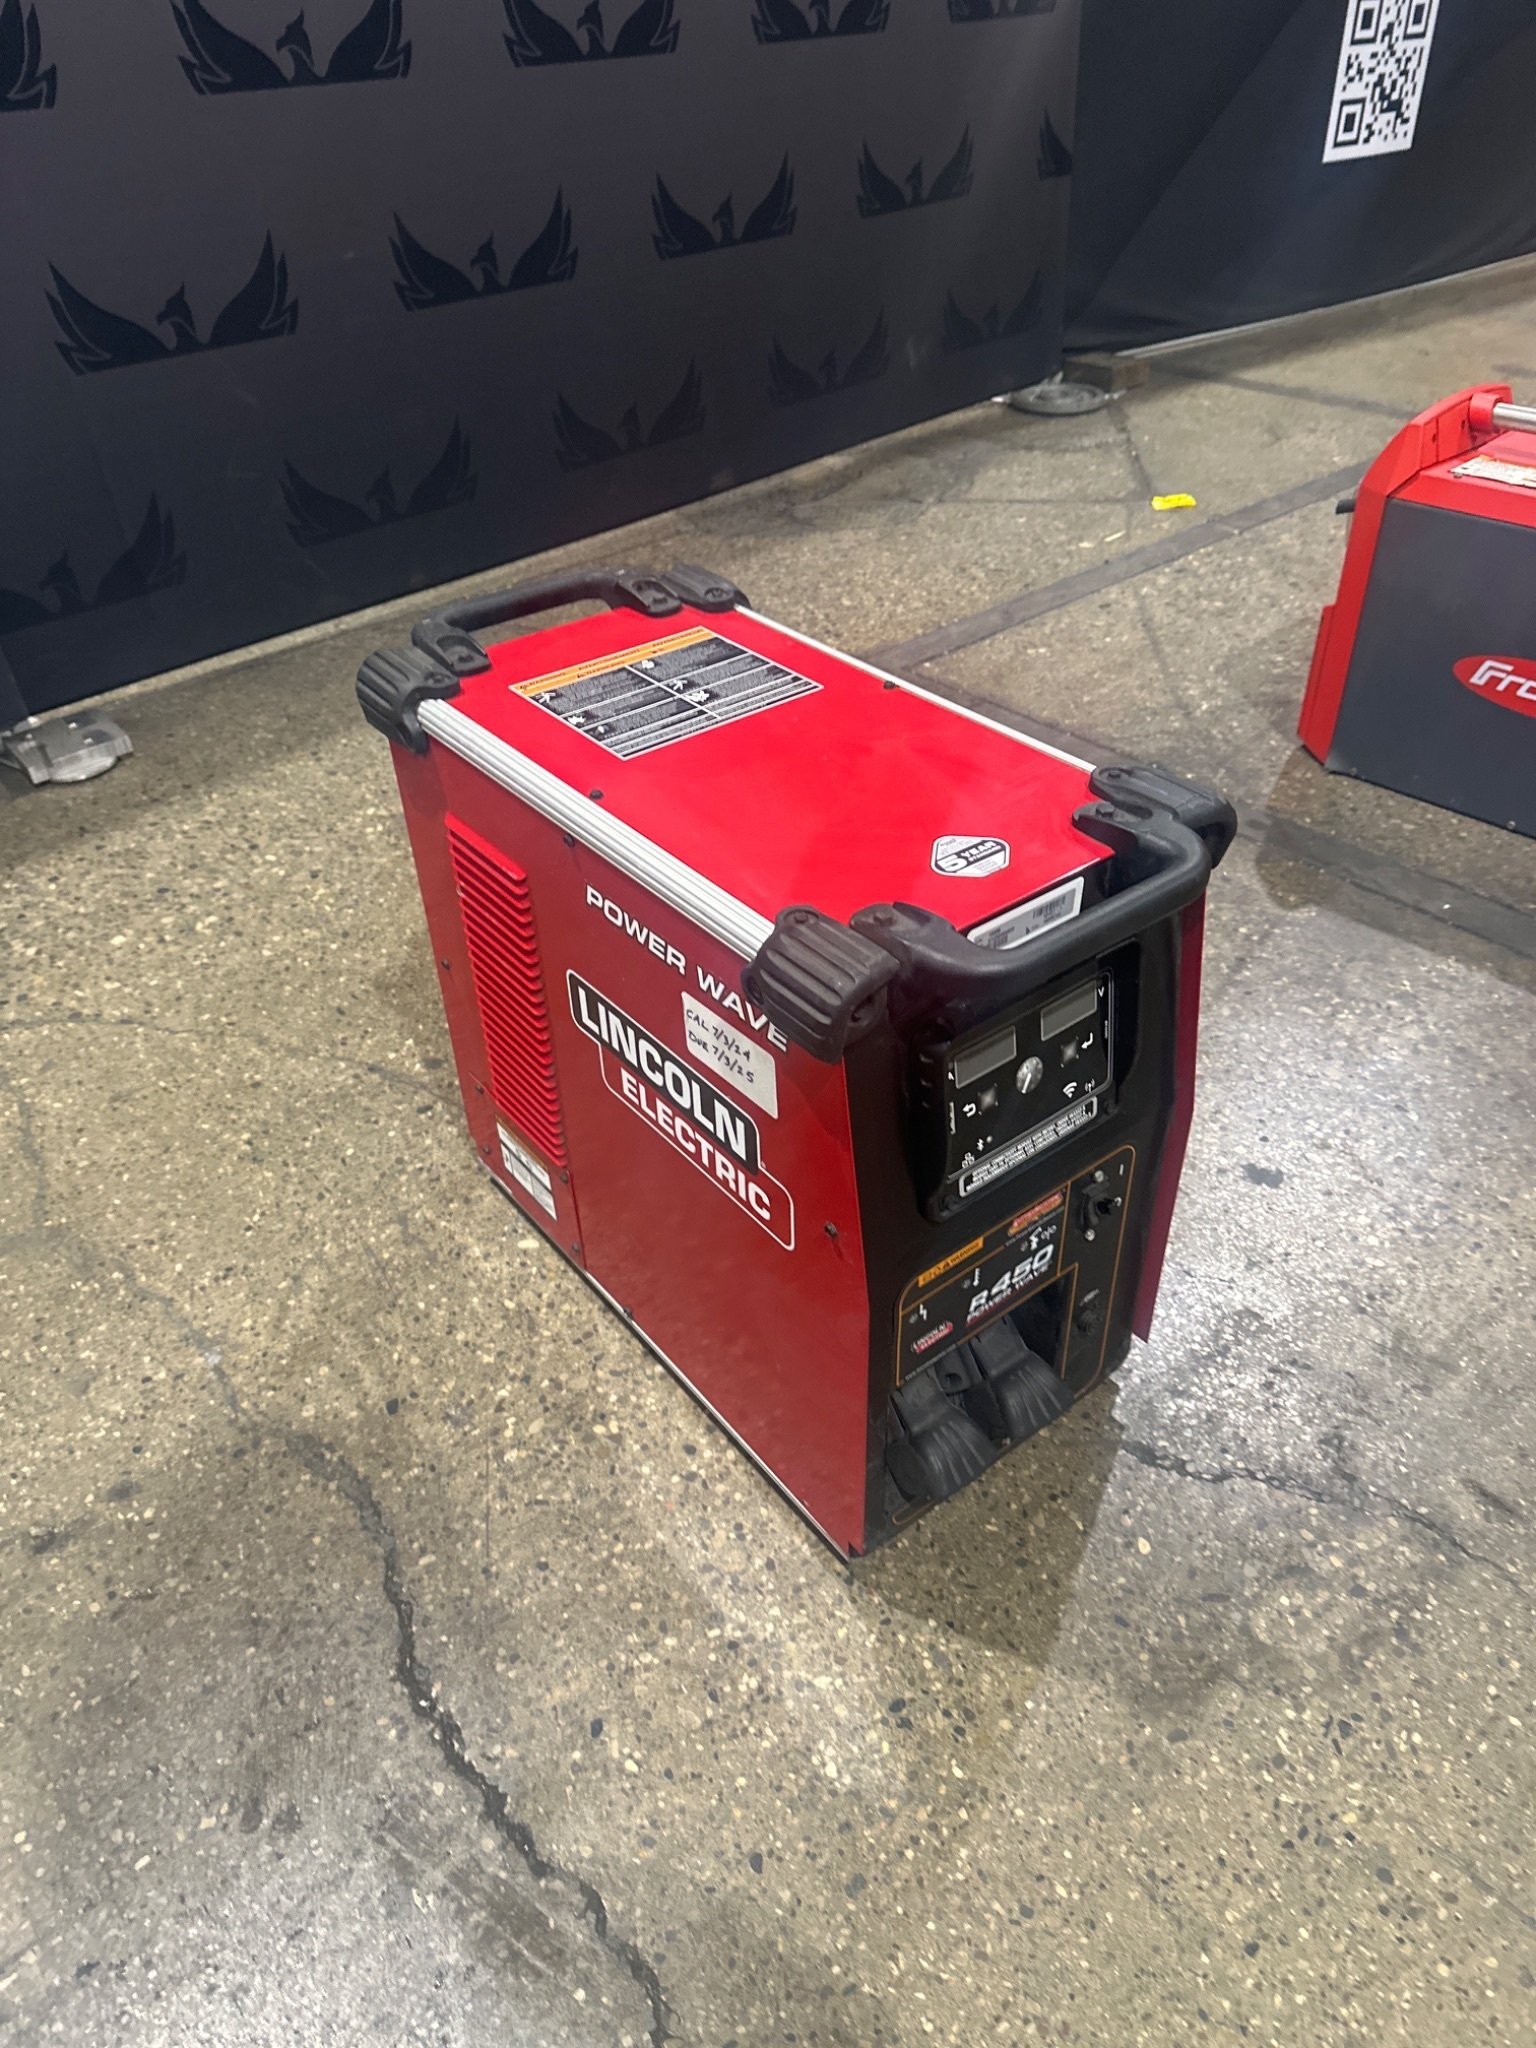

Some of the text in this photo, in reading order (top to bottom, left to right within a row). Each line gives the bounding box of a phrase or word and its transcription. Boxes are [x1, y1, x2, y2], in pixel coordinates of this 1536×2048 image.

[937, 853, 968, 872] 5
[960, 840, 997, 858] YEAR
[586, 884, 788, 1053] POWER WAVE
[686, 1009, 751, 1062] CAL 7/3/24
[688, 1030, 754, 1083] DUE 7/3/25
[577, 985, 747, 1161] LINCOLN
[620, 1067, 771, 1221] ELECTRIC
[968, 1243, 1055, 1313] R450
